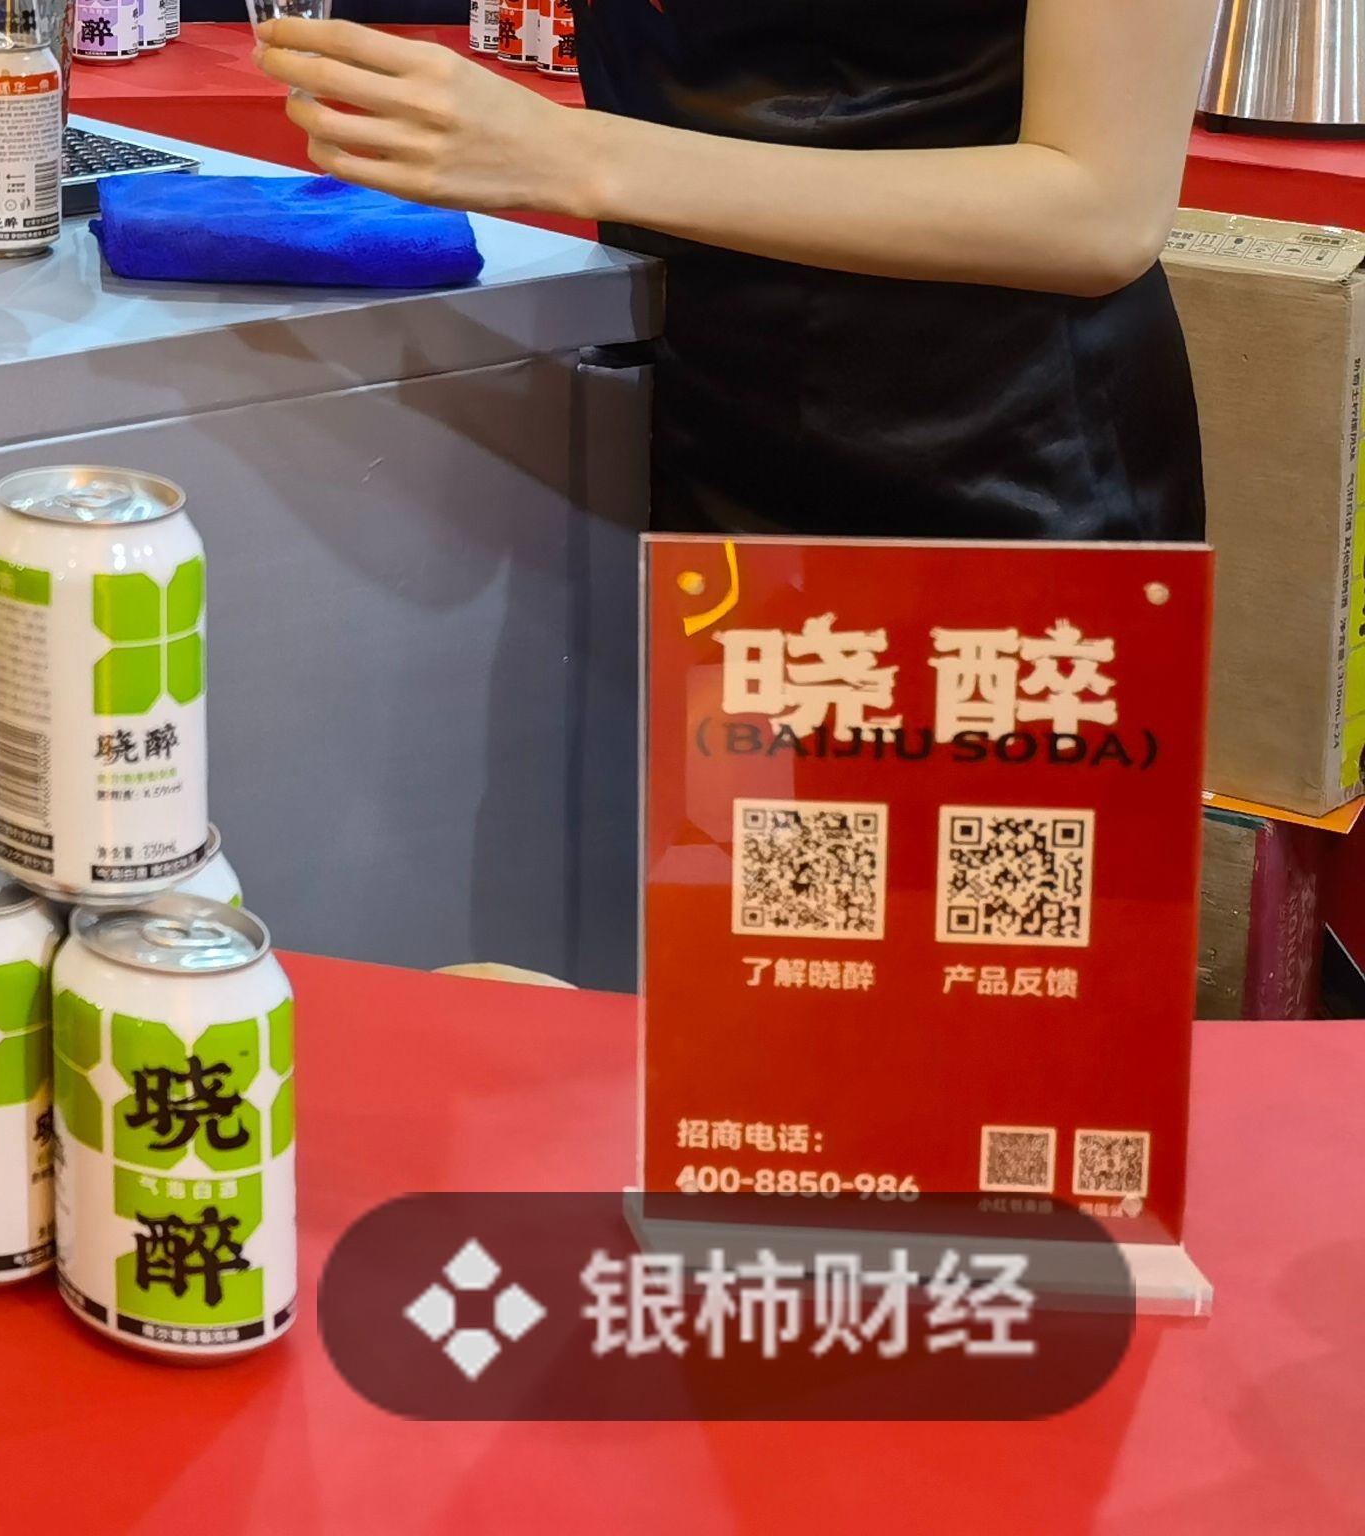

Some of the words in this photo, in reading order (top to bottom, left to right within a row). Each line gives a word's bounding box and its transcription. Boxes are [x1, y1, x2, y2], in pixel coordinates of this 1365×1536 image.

[711, 612, 1119, 751] 晓醉
[94, 722, 180, 764] 晓醉
[695, 714, 934, 765] (BAIJIU
[951, 728, 1159, 772] SODA)
[741, 956, 877, 992] 了解晓醉
[942, 963, 1078, 998] 产品反馈
[125, 1055, 251, 1308] 晓醉
[138, 1175, 240, 1200] 气泡白酒
[675, 1164, 920, 1204] 400-8850-986
